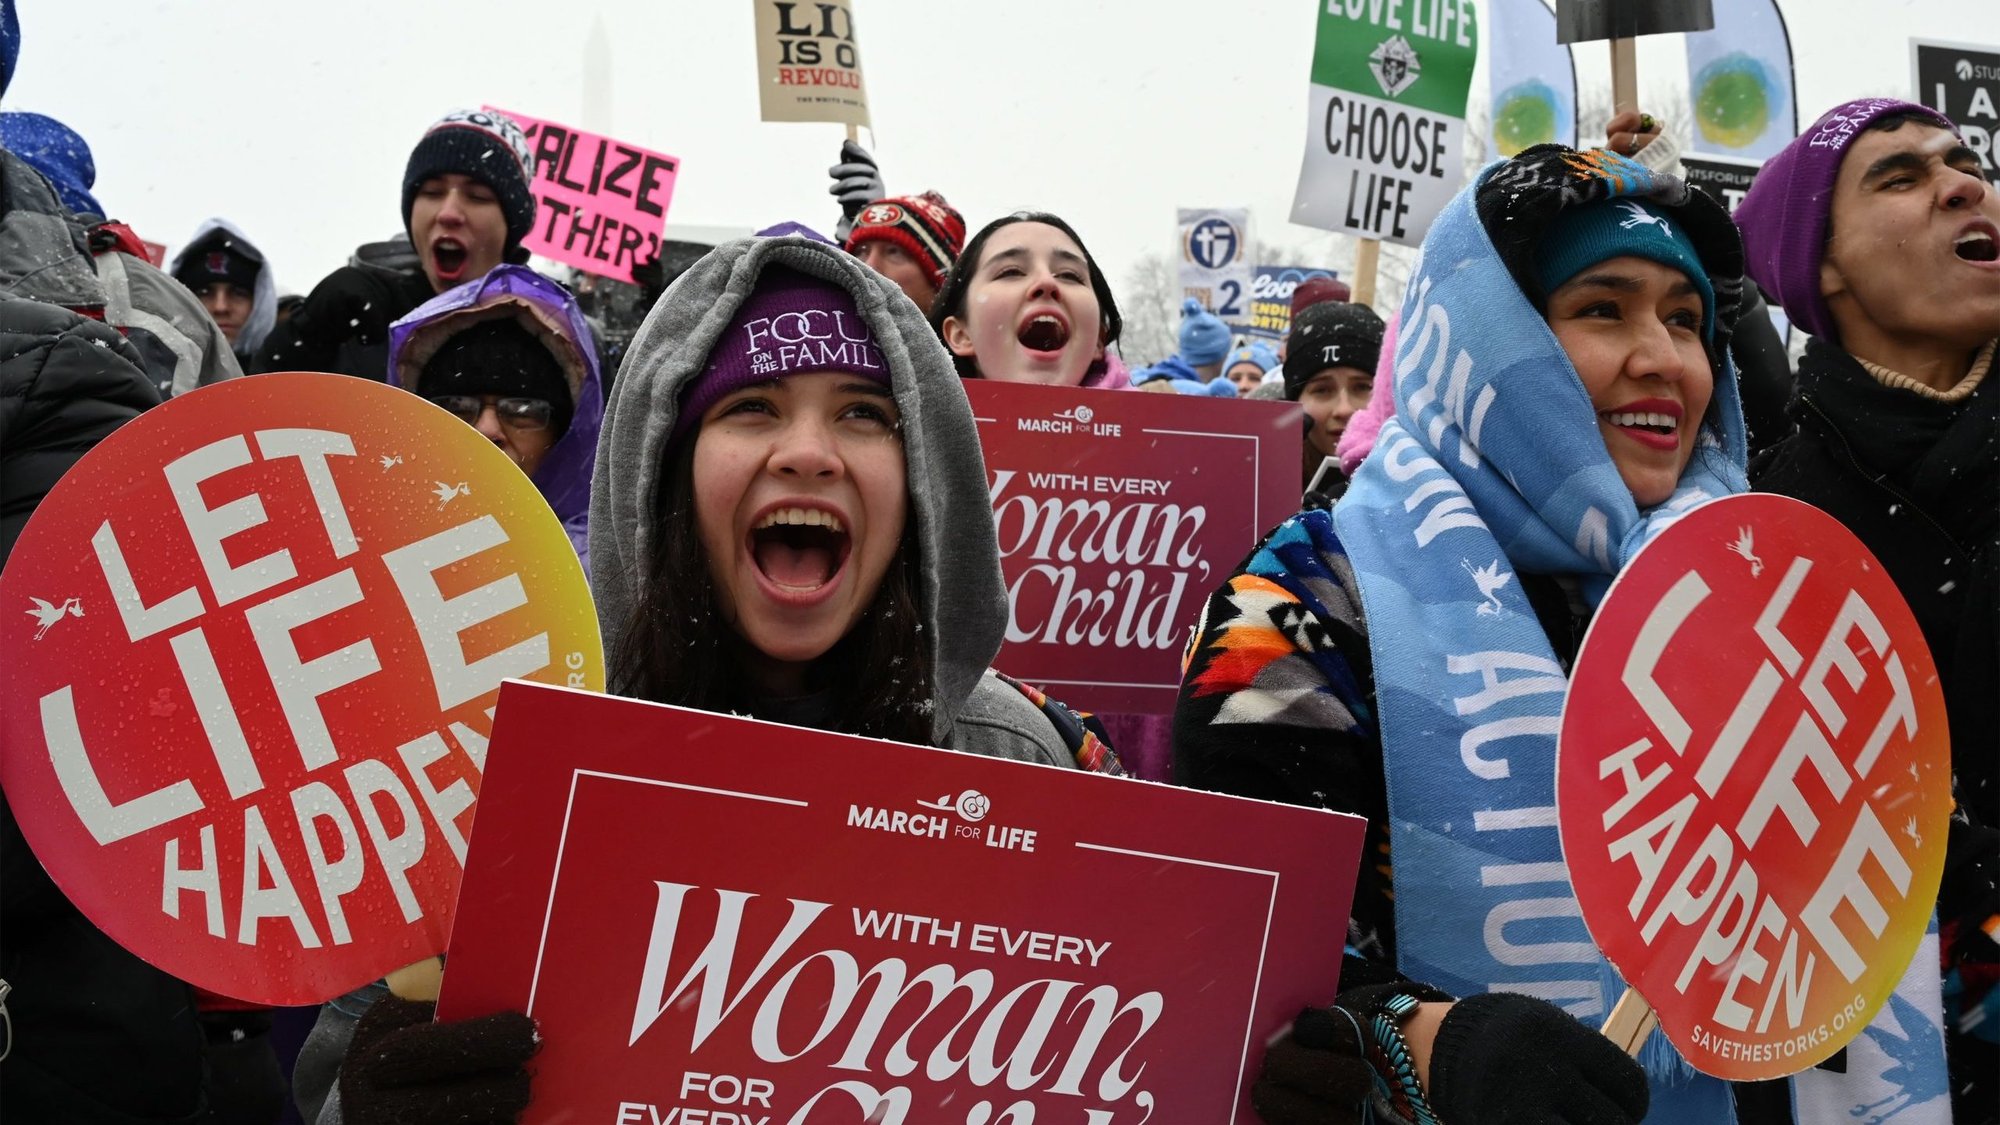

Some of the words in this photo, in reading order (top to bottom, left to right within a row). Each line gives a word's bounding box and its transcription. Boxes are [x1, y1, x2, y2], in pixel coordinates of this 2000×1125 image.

[778, 39, 822, 65] IS
[1412, 0, 1471, 47] LIFE
[1936, 83, 1947, 114] I
[1967, 87, 1998, 119] A
[1325, 96, 1447, 178] CHOOSE
[525, 123, 674, 218] ALIZE
[532, 193, 659, 267] THER?
[1345, 169, 1412, 238] LIFE
[1219, 280, 1240, 315] 2
[744, 310, 880, 354] FOCU
[753, 351, 772, 365] ON
[778, 341, 886, 371] FAMIL
[751, 360, 778, 374] THE
[1017, 418, 1072, 434] MARCH
[1075, 424, 1091, 433] FOR
[1093, 424, 1121, 437] LIFE
[1028, 472, 1088, 491] WITH
[1093, 477, 1171, 495] EVERY
[91, 428, 358, 642] LET
[1004, 564, 1188, 649] Child
[39, 514, 551, 846] LIFE
[1753, 556, 1918, 780] LET
[1621, 569, 1913, 985] LIFE
[847, 804, 948, 839] MARCH
[955, 825, 980, 839] FOR
[986, 825, 1037, 852] LIFE
[1599, 737, 1816, 1033] HAPPEN
[852, 907, 960, 950] WITH
[969, 924, 1111, 967] EVERY
[628, 880, 1164, 1125] Woman,
[1691, 994, 1866, 1062] SAVETHESTORKS.ORG
[680, 1071, 775, 1109] FOR
